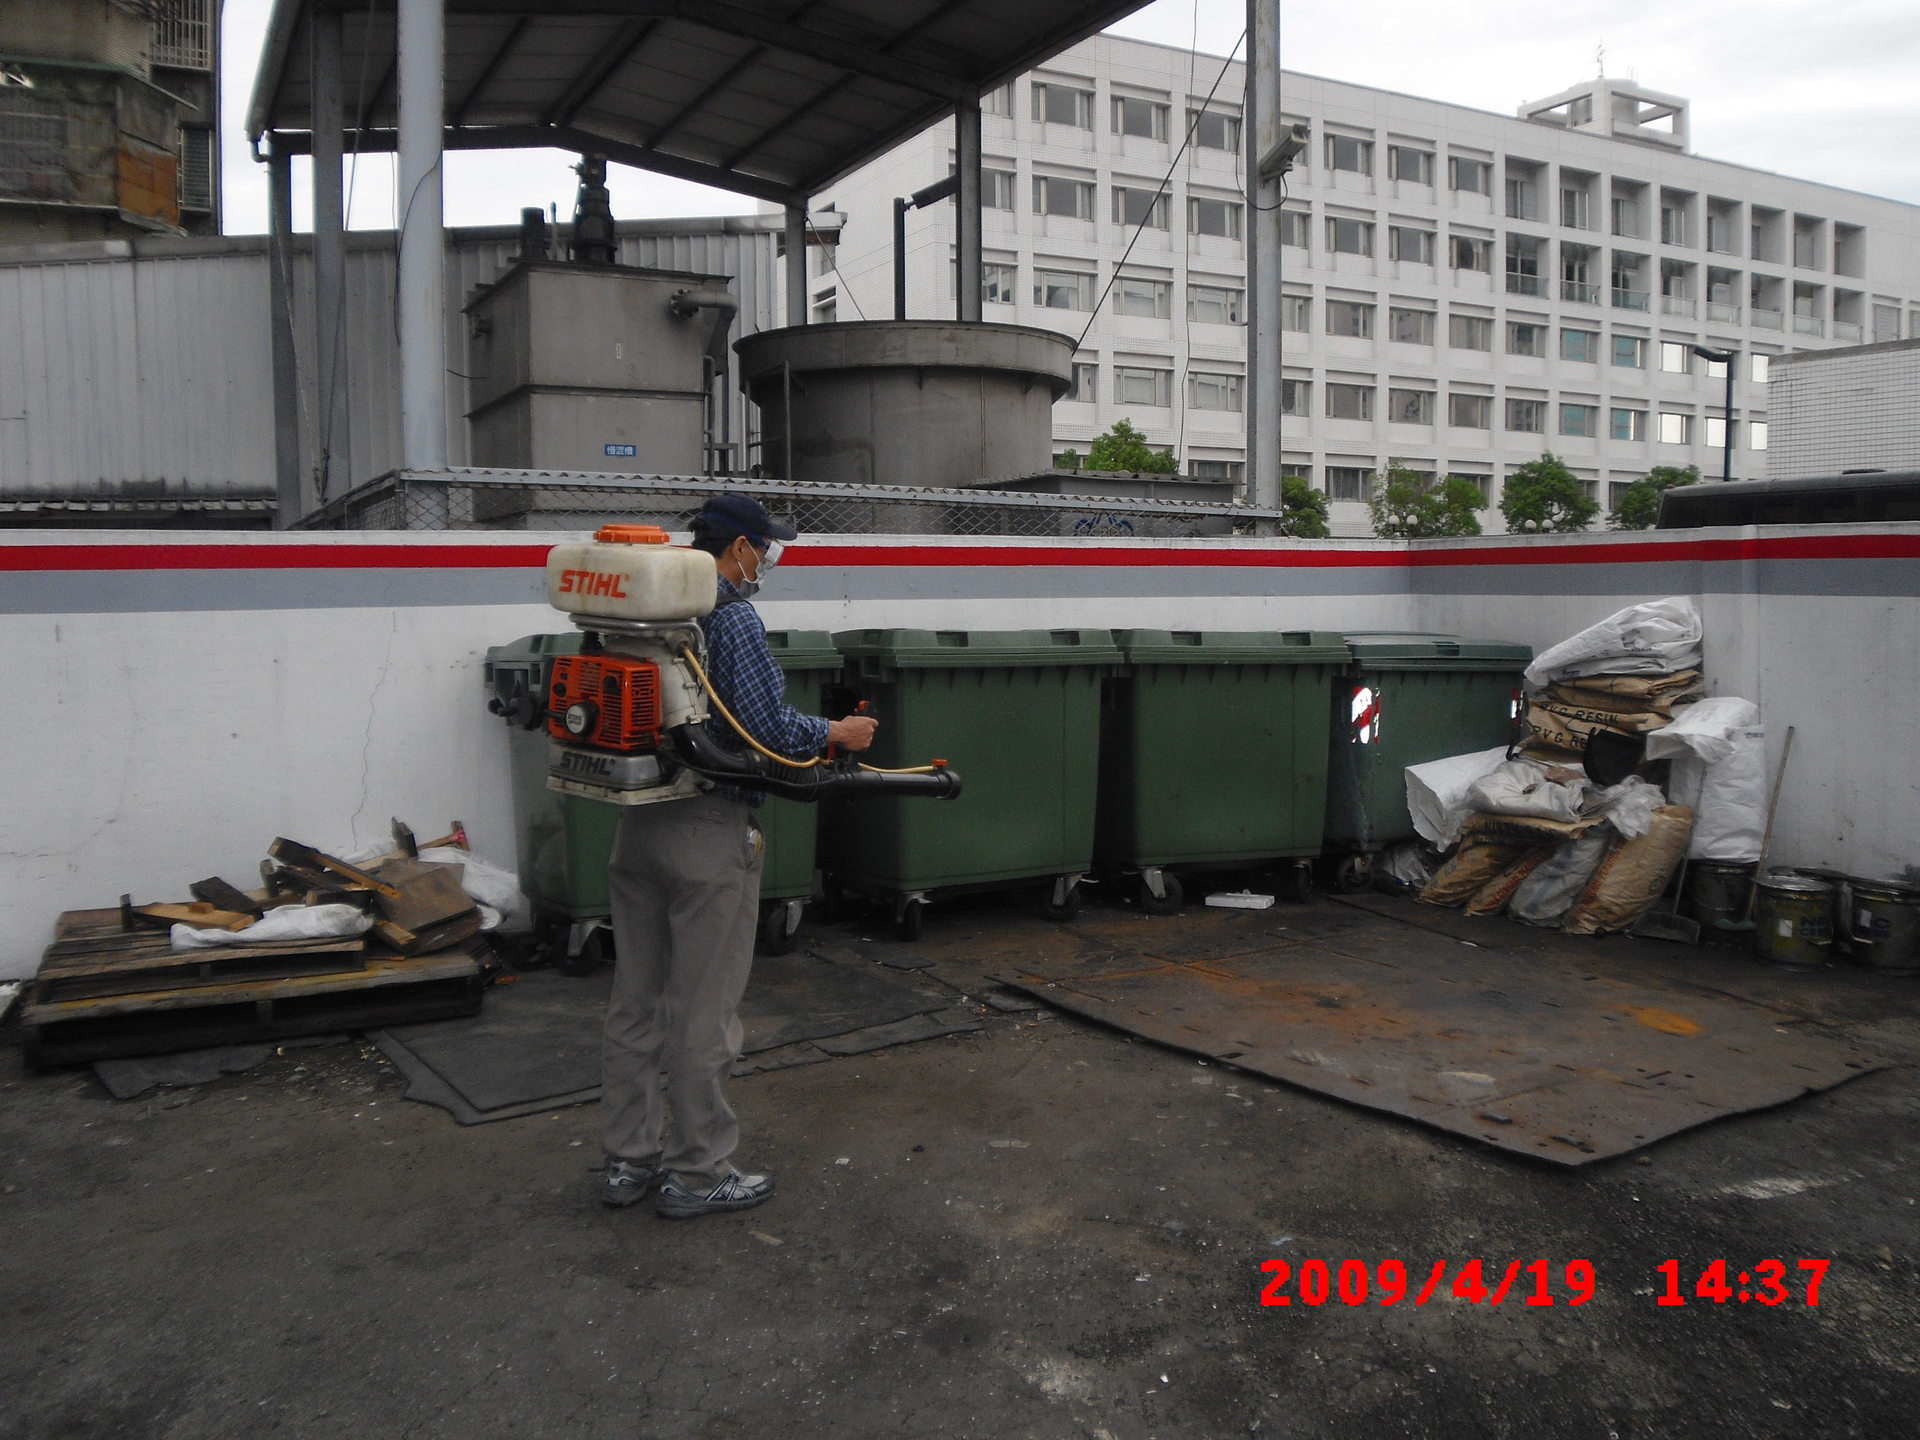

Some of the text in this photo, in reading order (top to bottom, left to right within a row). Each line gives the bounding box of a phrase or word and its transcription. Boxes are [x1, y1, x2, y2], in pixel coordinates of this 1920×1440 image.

[558, 569, 626, 598] STIHL
[1575, 708, 1618, 724] RESIN
[560, 751, 611, 776] STIHL
